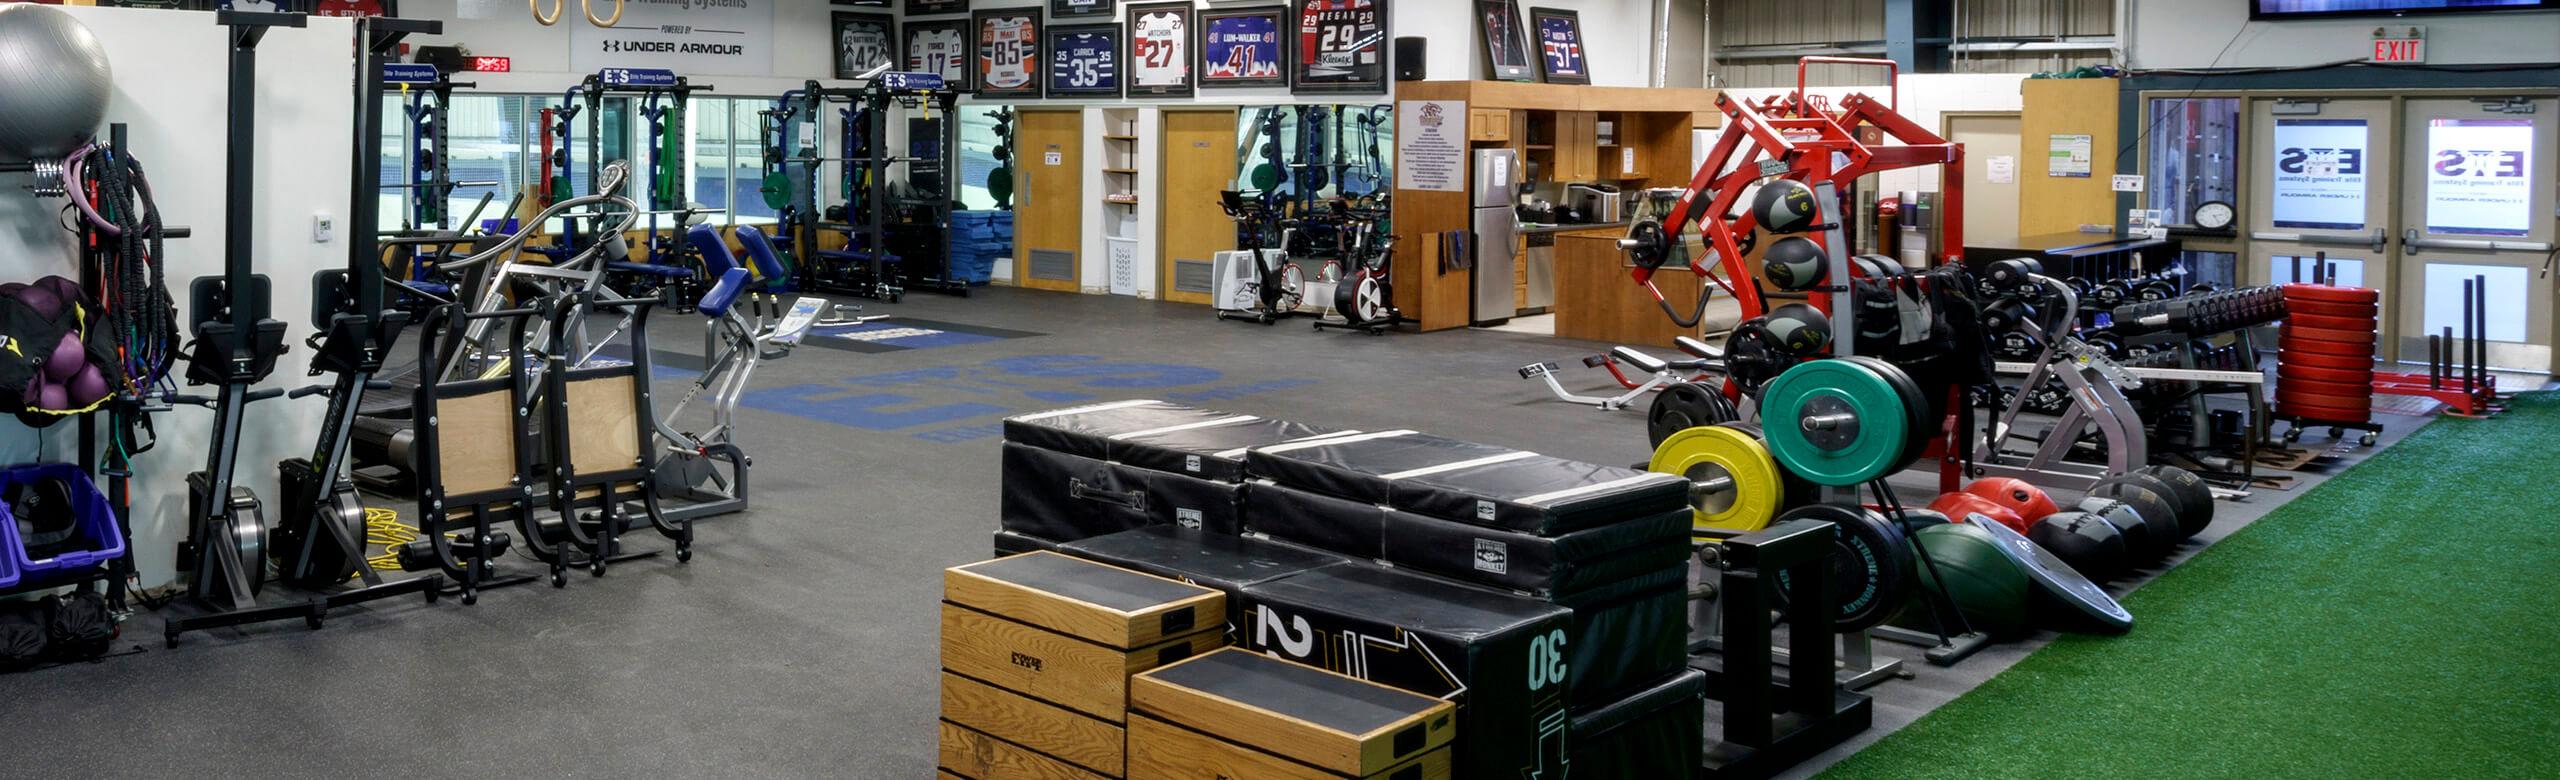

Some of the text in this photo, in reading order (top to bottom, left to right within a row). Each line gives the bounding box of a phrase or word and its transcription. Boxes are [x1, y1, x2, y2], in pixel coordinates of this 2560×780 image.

[1303, 15, 1318, 26] 29
[1319, 10, 1357, 21] REGAN
[1359, 11, 1374, 24] 29
[660, 25, 692, 34] POWERED BY
[1136, 20, 1147, 30] 27
[1171, 20, 1183, 30] 27
[1208, 32, 1218, 44] 41
[1223, 33, 1261, 42] LUM-WALKER
[1262, 31, 1275, 43] 41
[1321, 24, 1356, 51] 29
[623, 41, 743, 55] UNDER ARMOUR
[912, 44, 921, 54] 17
[951, 43, 960, 53] 17
[994, 40, 1019, 66] 85
[1145, 39, 1174, 68] 27
[2375, 40, 2420, 61] EXIT
[855, 46, 878, 69] 42
[1056, 50, 1068, 61] 35
[1098, 51, 1111, 62] 35
[1227, 44, 1256, 74] 41
[1554, 42, 1570, 68] 57
[927, 53, 946, 76] 17
[1069, 58, 1099, 87] 35
[1800, 201, 1809, 211] 6
[1842, 534, 1879, 615] XTREME MONKEY
[1528, 628, 1567, 692] 30
